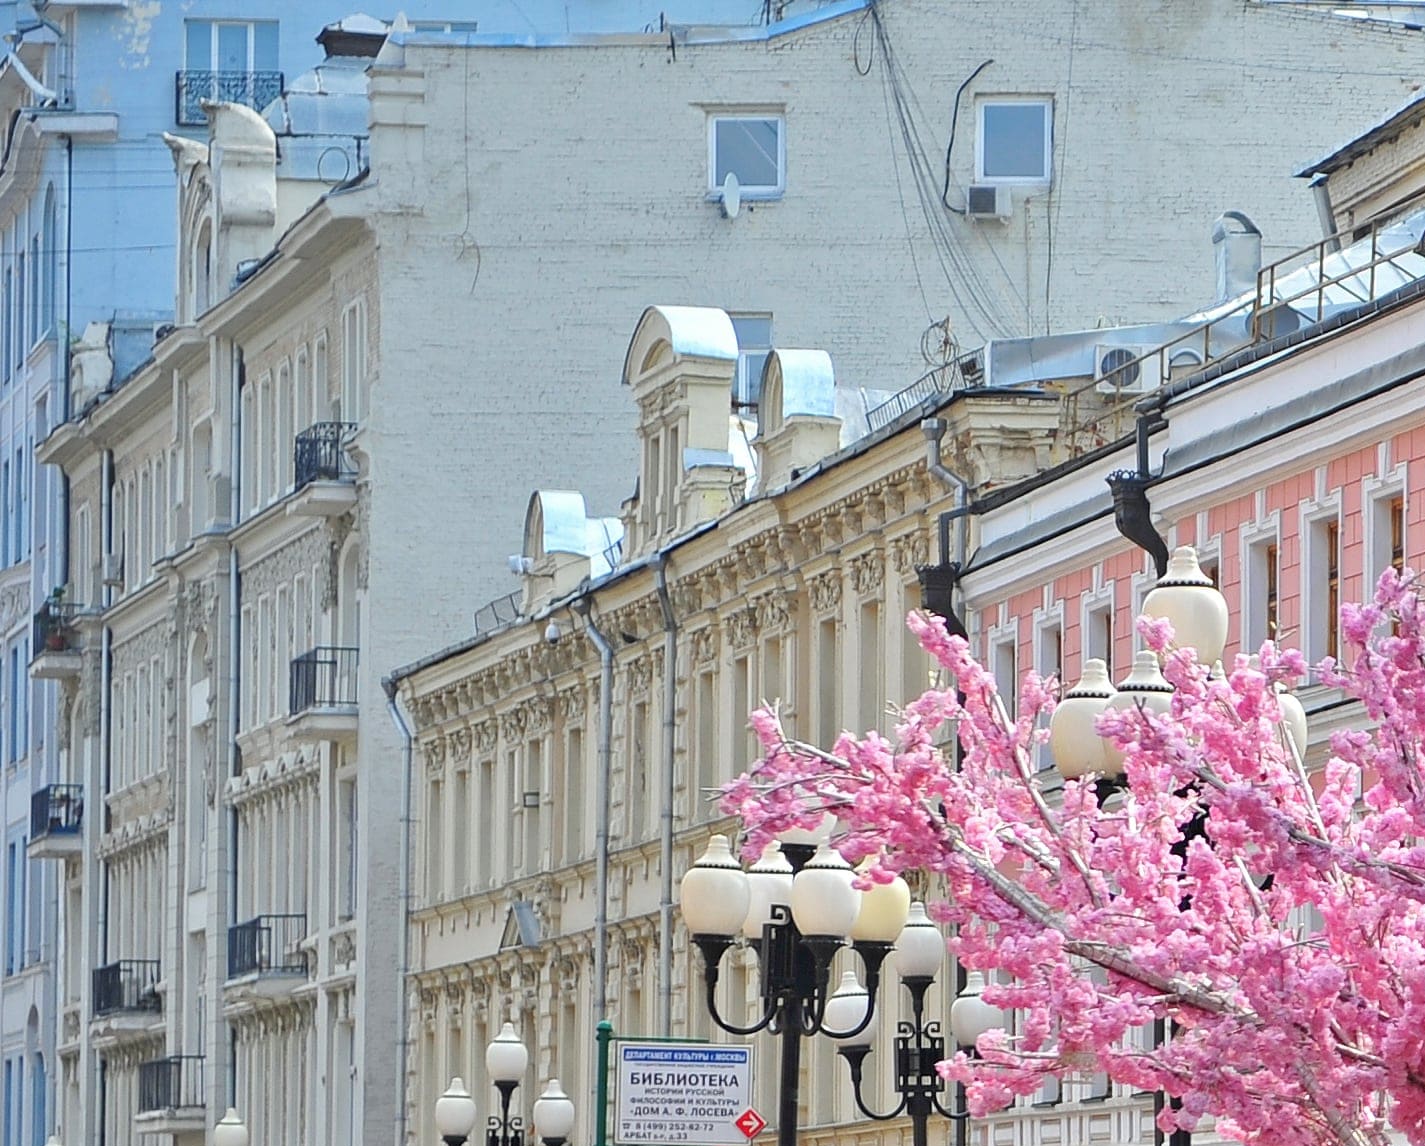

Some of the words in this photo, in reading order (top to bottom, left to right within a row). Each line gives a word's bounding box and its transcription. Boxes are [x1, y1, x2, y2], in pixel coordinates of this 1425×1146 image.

[673, 1051, 708, 1061] КУЛЬТУРЫ
[630, 1072, 739, 1087] БИБЛИОТЕКА
[644, 1088, 683, 1096] ИСТОРИИ
[685, 1088, 725, 1097] РУССКОЙ
[630, 1097, 686, 1105] ФИЛОСОФИИ
[695, 1098, 740, 1106] КУЛЬТУРЫ
[662, 1107, 673, 1116] А.
[675, 1107, 688, 1117] Ф.
[643, 1122, 667, 1132] (499)
[624, 1132, 652, 1140] АРБАТ
